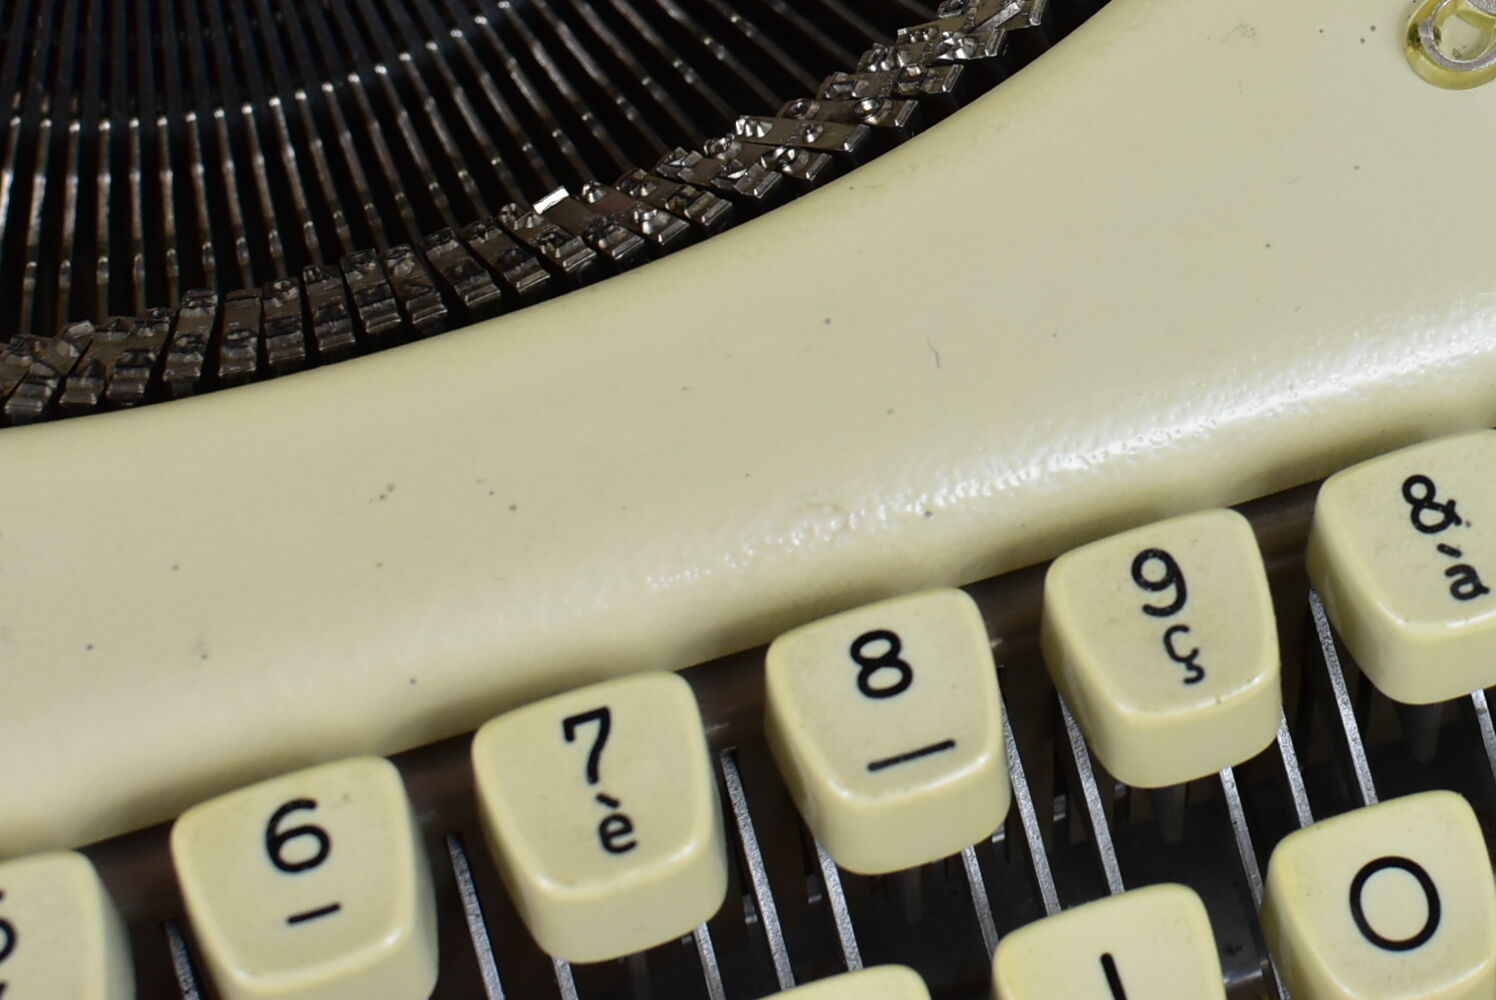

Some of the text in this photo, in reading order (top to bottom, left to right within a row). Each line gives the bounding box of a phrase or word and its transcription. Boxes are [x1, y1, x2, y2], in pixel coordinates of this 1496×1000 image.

[1400, 473, 1464, 536] &
[1129, 547, 1189, 619] 9
[848, 628, 915, 701] 8
[560, 704, 613, 786] 7
[263, 796, 332, 875] 6
[594, 792, 638, 856] è
[1347, 855, 1443, 954] O
